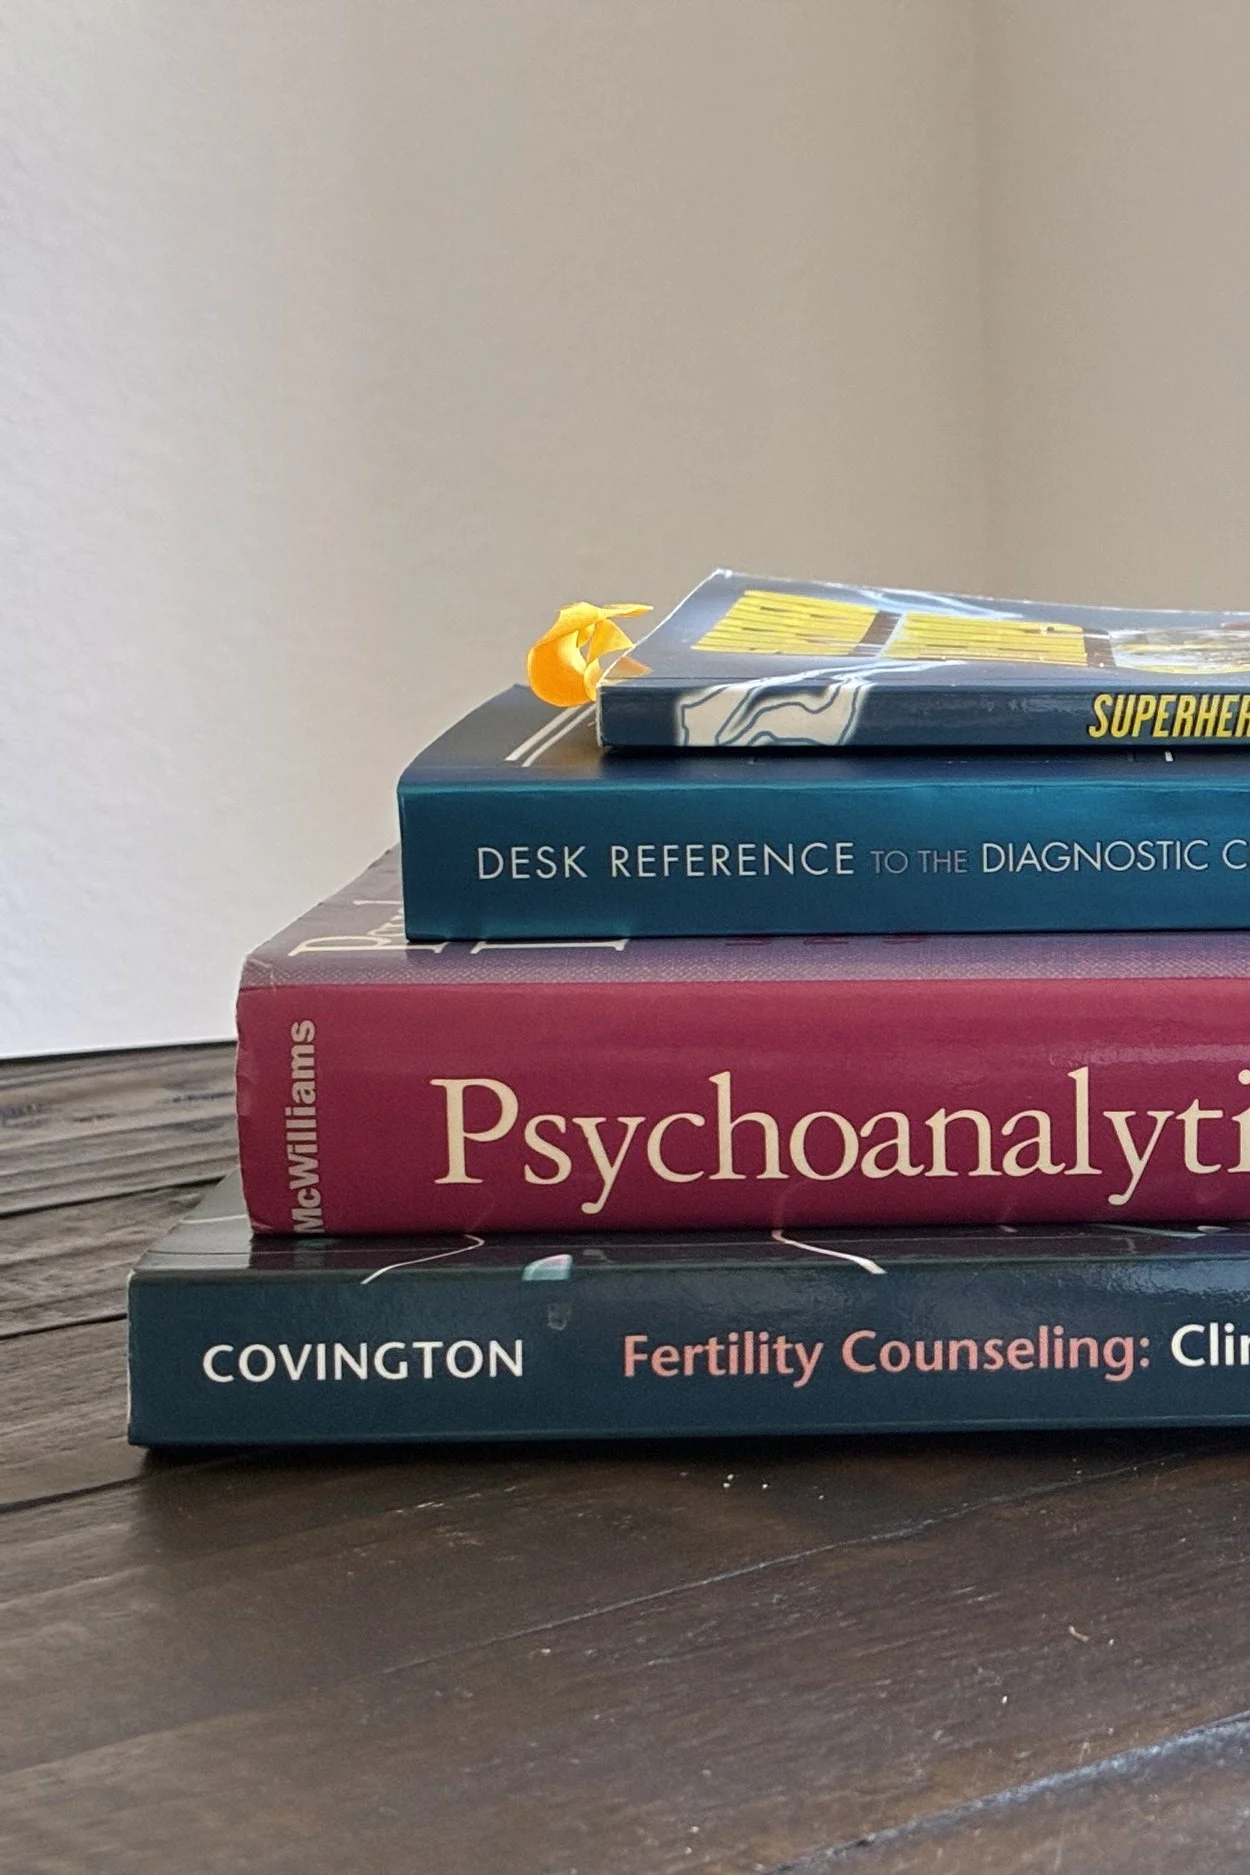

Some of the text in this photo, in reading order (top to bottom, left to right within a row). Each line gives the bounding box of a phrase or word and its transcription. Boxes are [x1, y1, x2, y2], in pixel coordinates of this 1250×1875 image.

[477, 845, 588, 880] DESK
[611, 842, 854, 877] REFERENCE
[870, 850, 908, 874] TO
[918, 849, 968, 873] THE
[982, 840, 1209, 873] DIAGNOSTIC
[285, 1019, 325, 1234] McWilliams
[202, 1339, 524, 1383] COVINGTON
[622, 1331, 823, 1388] Fertility
[841, 1326, 1151, 1382] Counseling:
